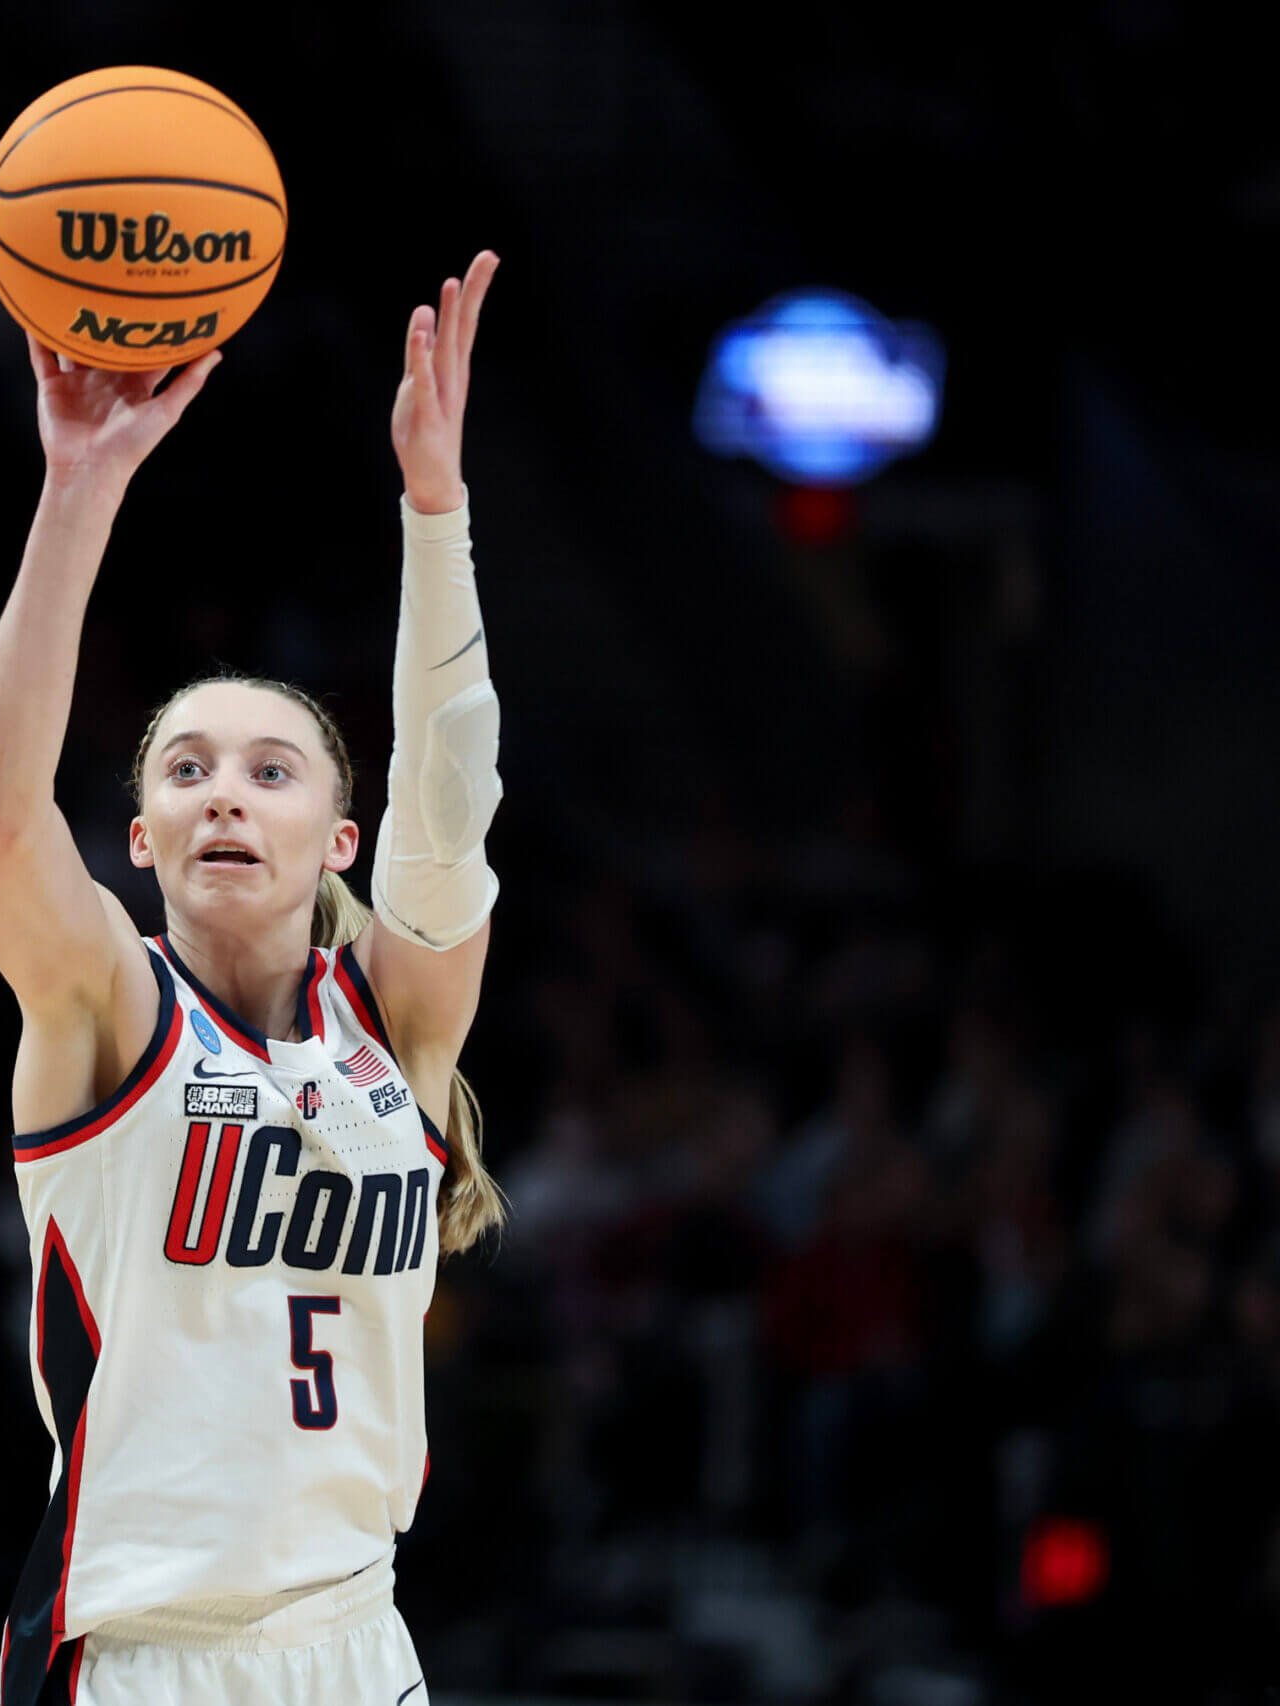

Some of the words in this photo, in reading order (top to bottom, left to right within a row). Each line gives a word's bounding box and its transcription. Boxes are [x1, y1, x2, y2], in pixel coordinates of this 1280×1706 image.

[56, 210, 251, 264] Wilson
[70, 308, 218, 348] NCAA
[369, 1081, 396, 1102] BIG
[373, 1088, 408, 1113] EAST
[187, 1102, 255, 1115] CHANGE
[287, 1295, 341, 1431] 5
